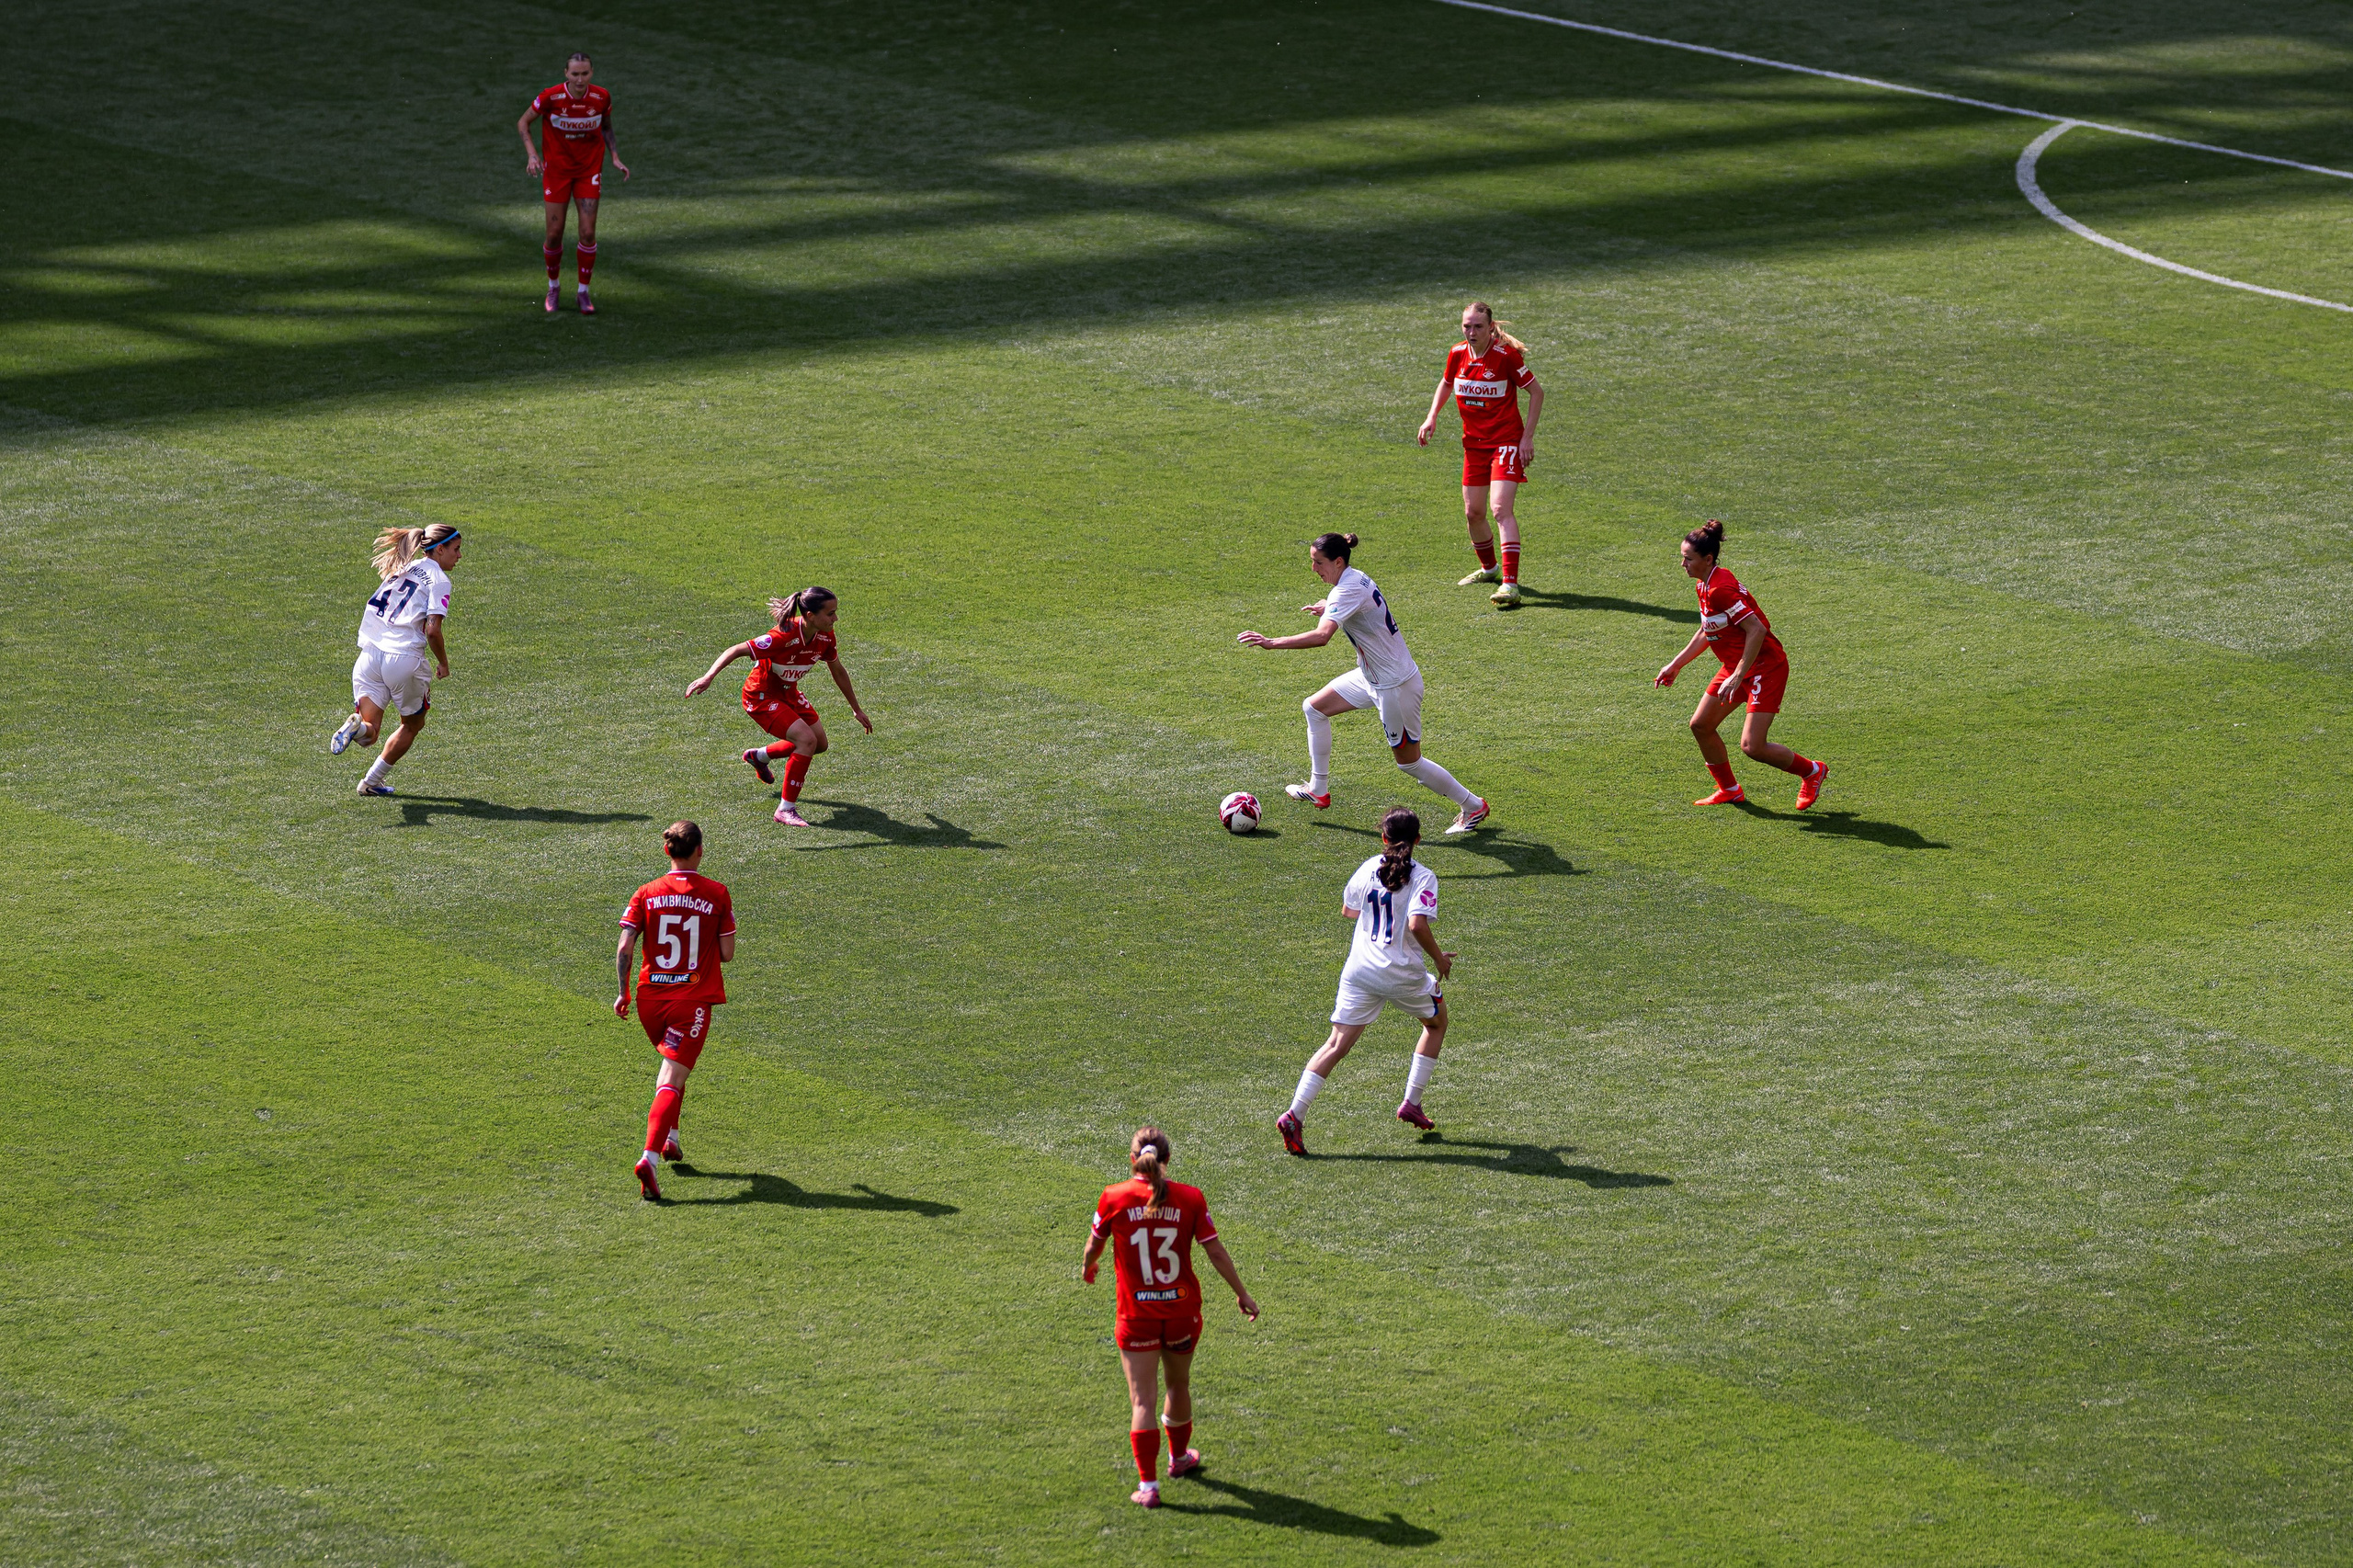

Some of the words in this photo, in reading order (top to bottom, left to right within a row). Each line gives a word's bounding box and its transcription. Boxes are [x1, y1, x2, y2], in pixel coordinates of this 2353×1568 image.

[1458, 384, 1497, 395] ЛУКОЙЛ
[1498, 446, 1518, 466] 77
[368, 578, 419, 625] 47
[1751, 676, 1762, 696] 3
[646, 894, 714, 915] ГЖИВИНЬСКА
[1367, 889, 1393, 945] 11
[654, 915, 700, 970] 51
[651, 973, 689, 983] WINLINE
[1130, 1227, 1180, 1286] 13
[1136, 1289, 1177, 1301] WINLINE
